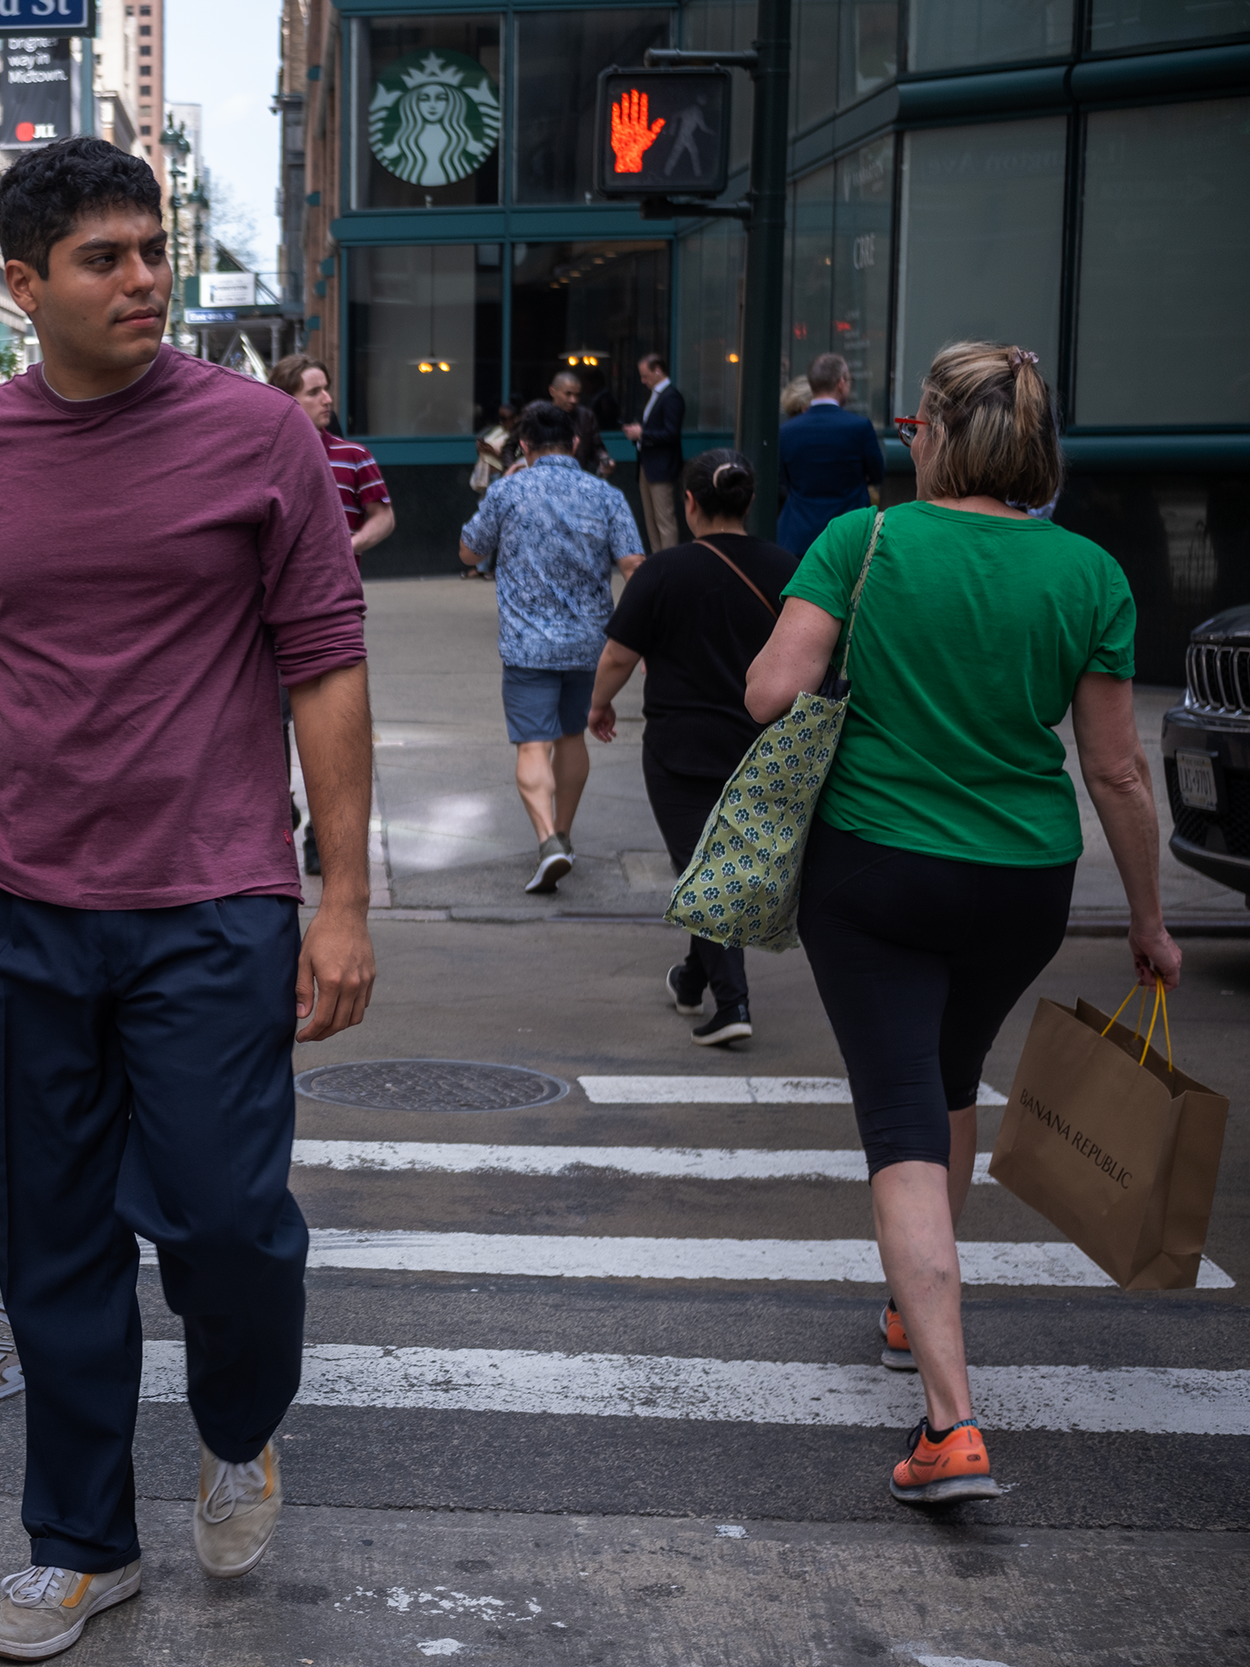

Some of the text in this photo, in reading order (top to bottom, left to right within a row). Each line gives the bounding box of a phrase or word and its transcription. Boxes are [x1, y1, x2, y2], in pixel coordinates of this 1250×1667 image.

[31, 0, 71, 16] St
[7, 51, 51, 69] way in
[8, 69, 69, 84] Midtown.
[1019, 1088, 1133, 1190] BANANA REPUBLIC
